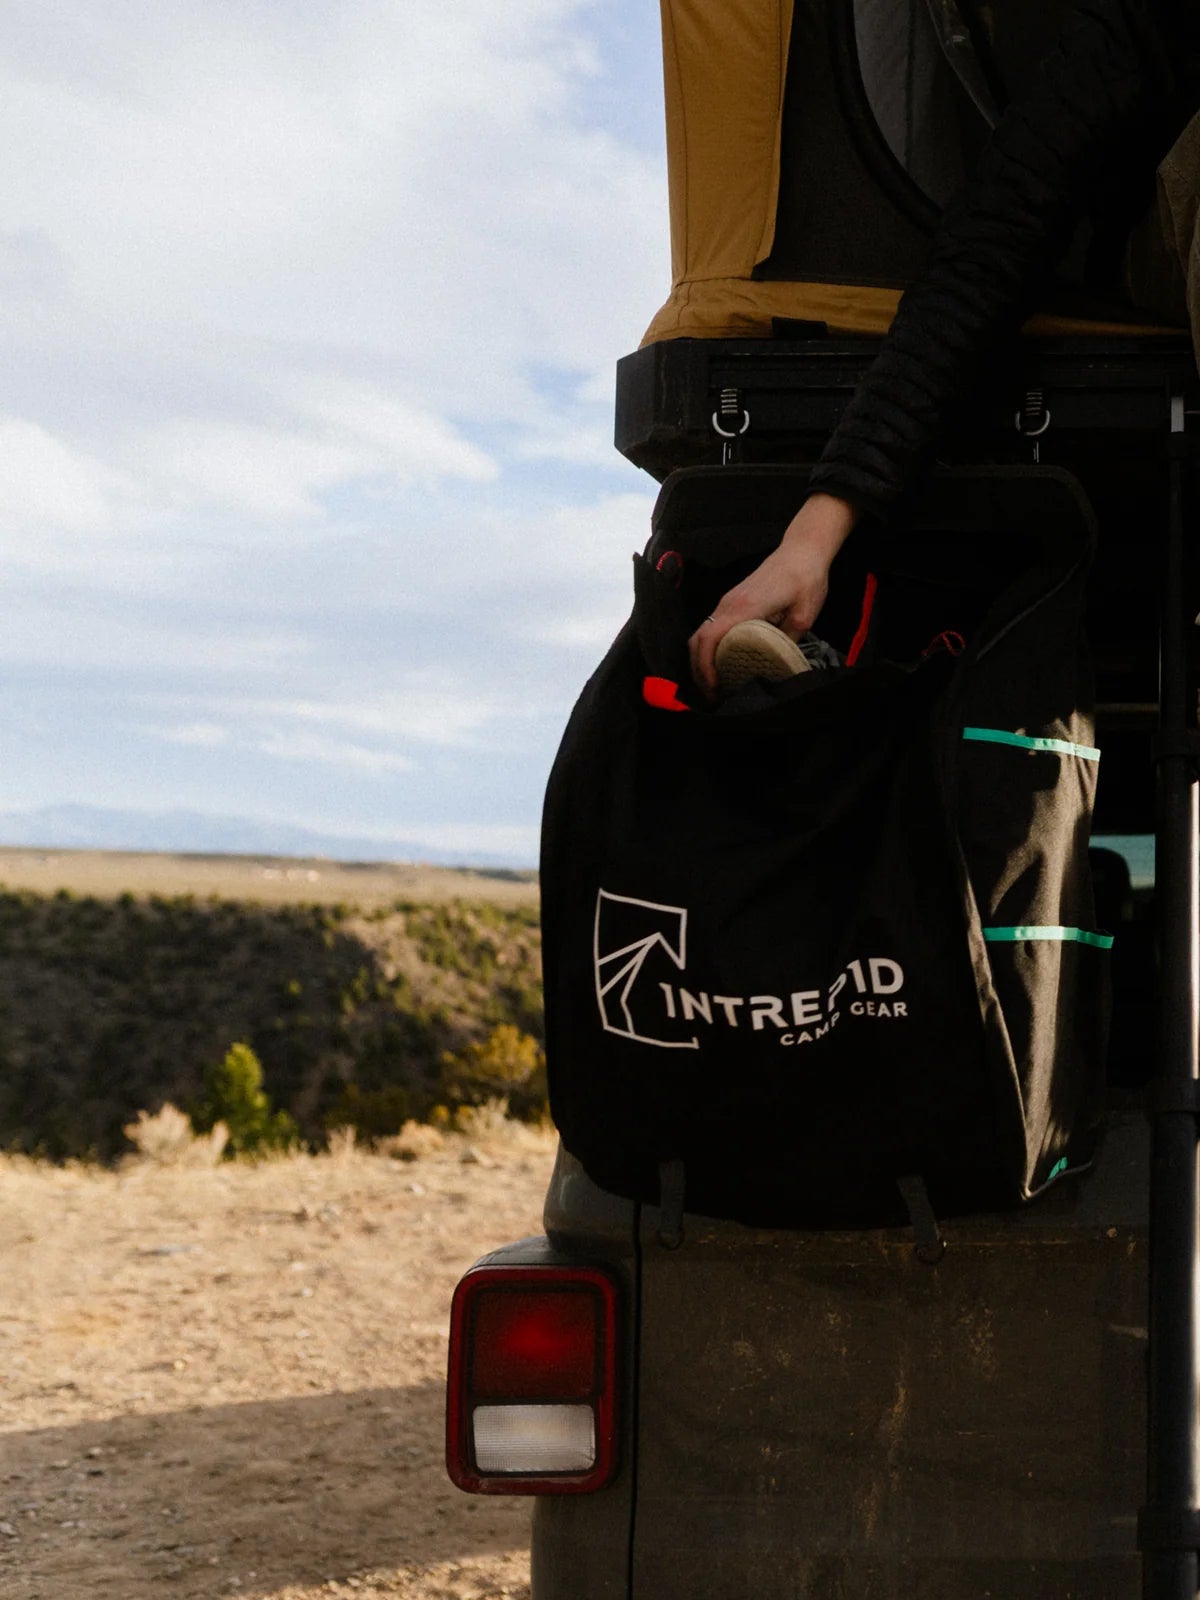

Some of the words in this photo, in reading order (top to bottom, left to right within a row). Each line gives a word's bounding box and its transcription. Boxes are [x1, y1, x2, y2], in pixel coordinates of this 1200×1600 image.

[658, 957, 905, 1031] INTREPID
[780, 1011, 841, 1046] CAMP
[849, 1001, 908, 1018] GEAR
